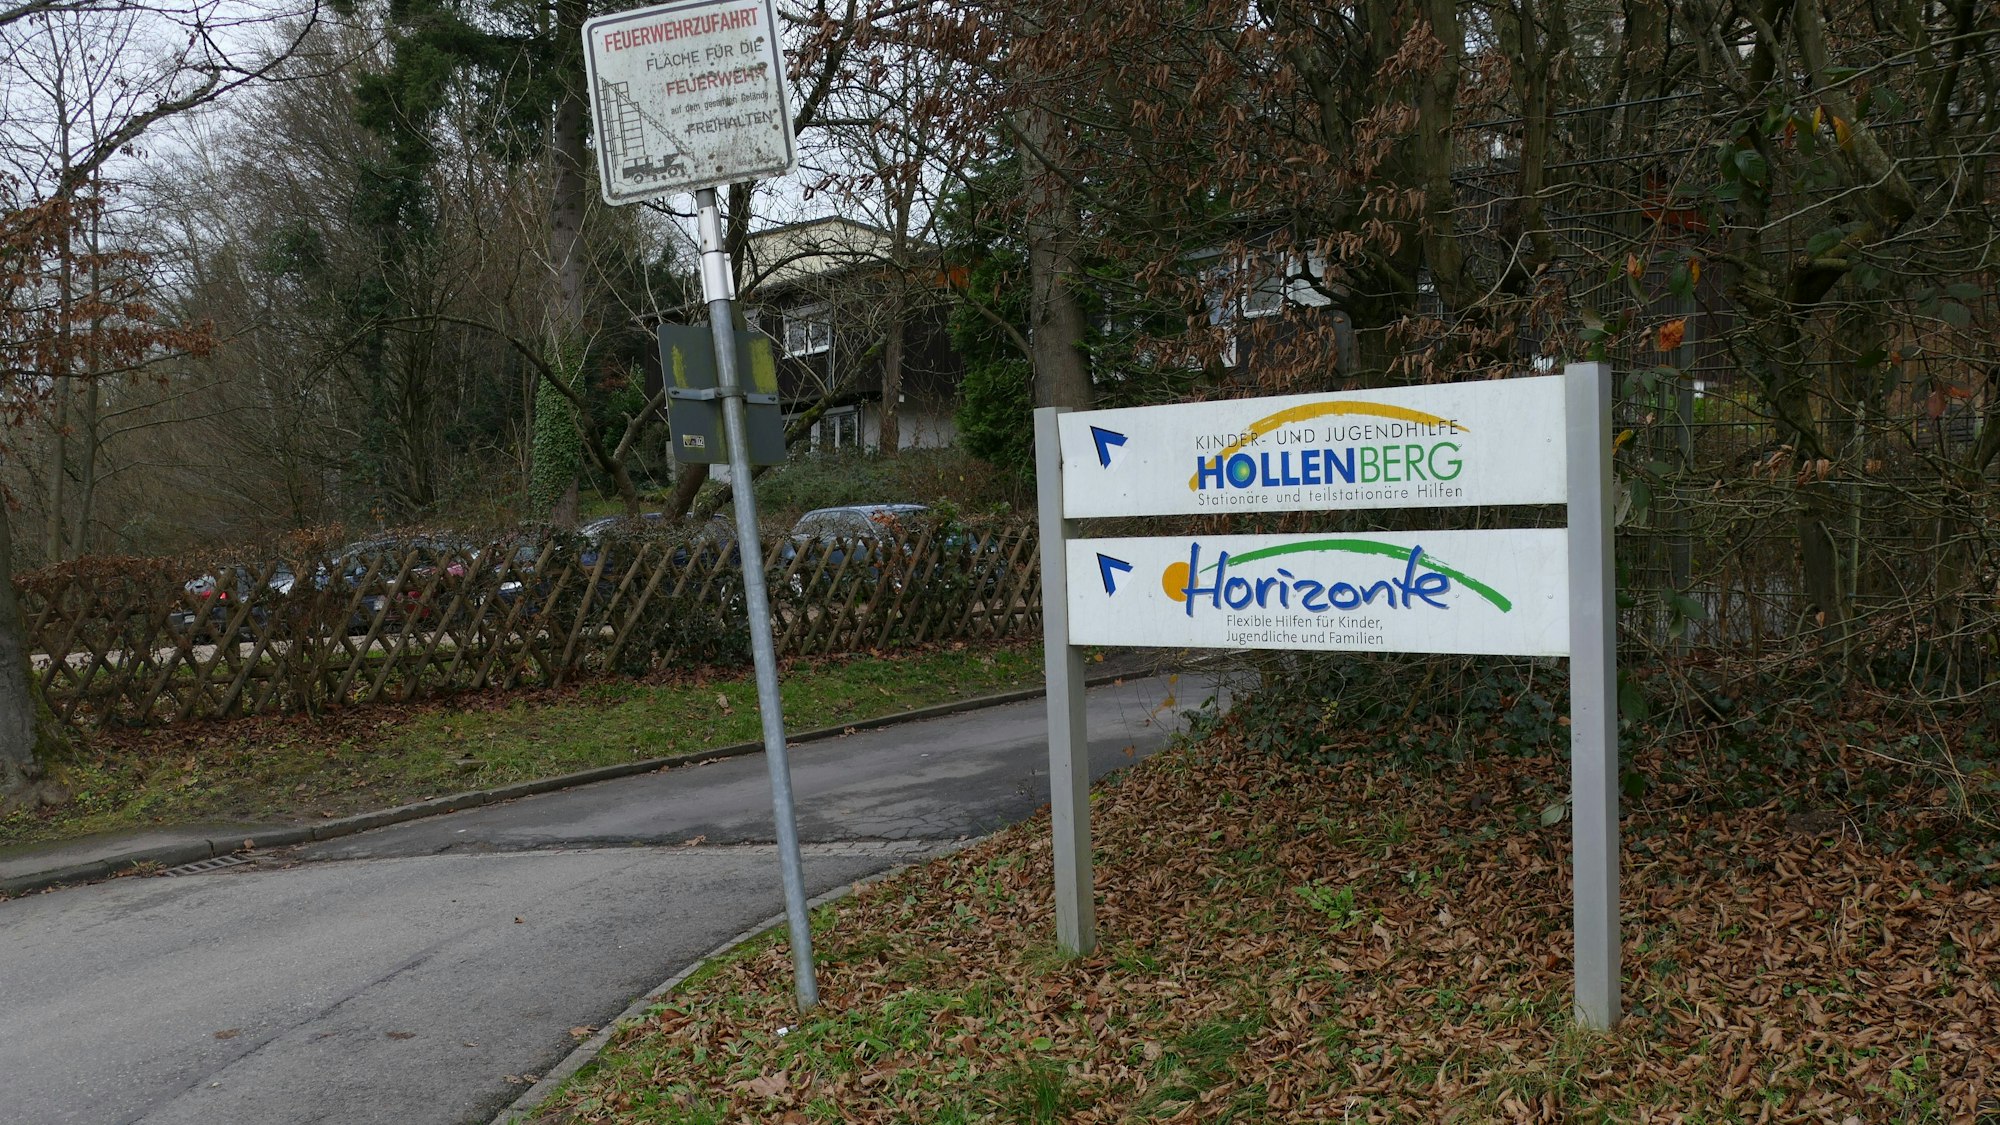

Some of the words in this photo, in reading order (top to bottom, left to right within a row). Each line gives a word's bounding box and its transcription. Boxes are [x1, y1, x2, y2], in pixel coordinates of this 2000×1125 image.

[604, 7, 758, 52] FEUERWEHRZUFAHRT
[646, 50, 700, 71] FLÄCHE
[705, 44, 734, 60] FÜR
[740, 40, 762, 54] DIE
[671, 104, 682, 115] auf
[685, 103, 700, 113] dem
[686, 110, 773, 136] FREIHALTEN
[1196, 432, 1266, 449] KINDER-
[1276, 428, 1315, 445] UND
[1325, 420, 1458, 442] JUGENDHILFE
[1197, 441, 1463, 490] HOLLENBERG
[1198, 490, 1268, 505] Stationäre
[1276, 488, 1300, 502] und
[1309, 485, 1408, 502] teilstationäre
[1417, 482, 1463, 498] Hilfen
[1181, 542, 1450, 617] Horizonte
[1226, 615, 1272, 627] Flexible
[1276, 615, 1312, 628] Hilfen
[1316, 616, 1334, 628] für
[1338, 616, 1383, 630] Kinder,
[1226, 630, 1297, 645] Jugendliche
[1301, 631, 1325, 643] und
[1329, 632, 1384, 644] Familien
